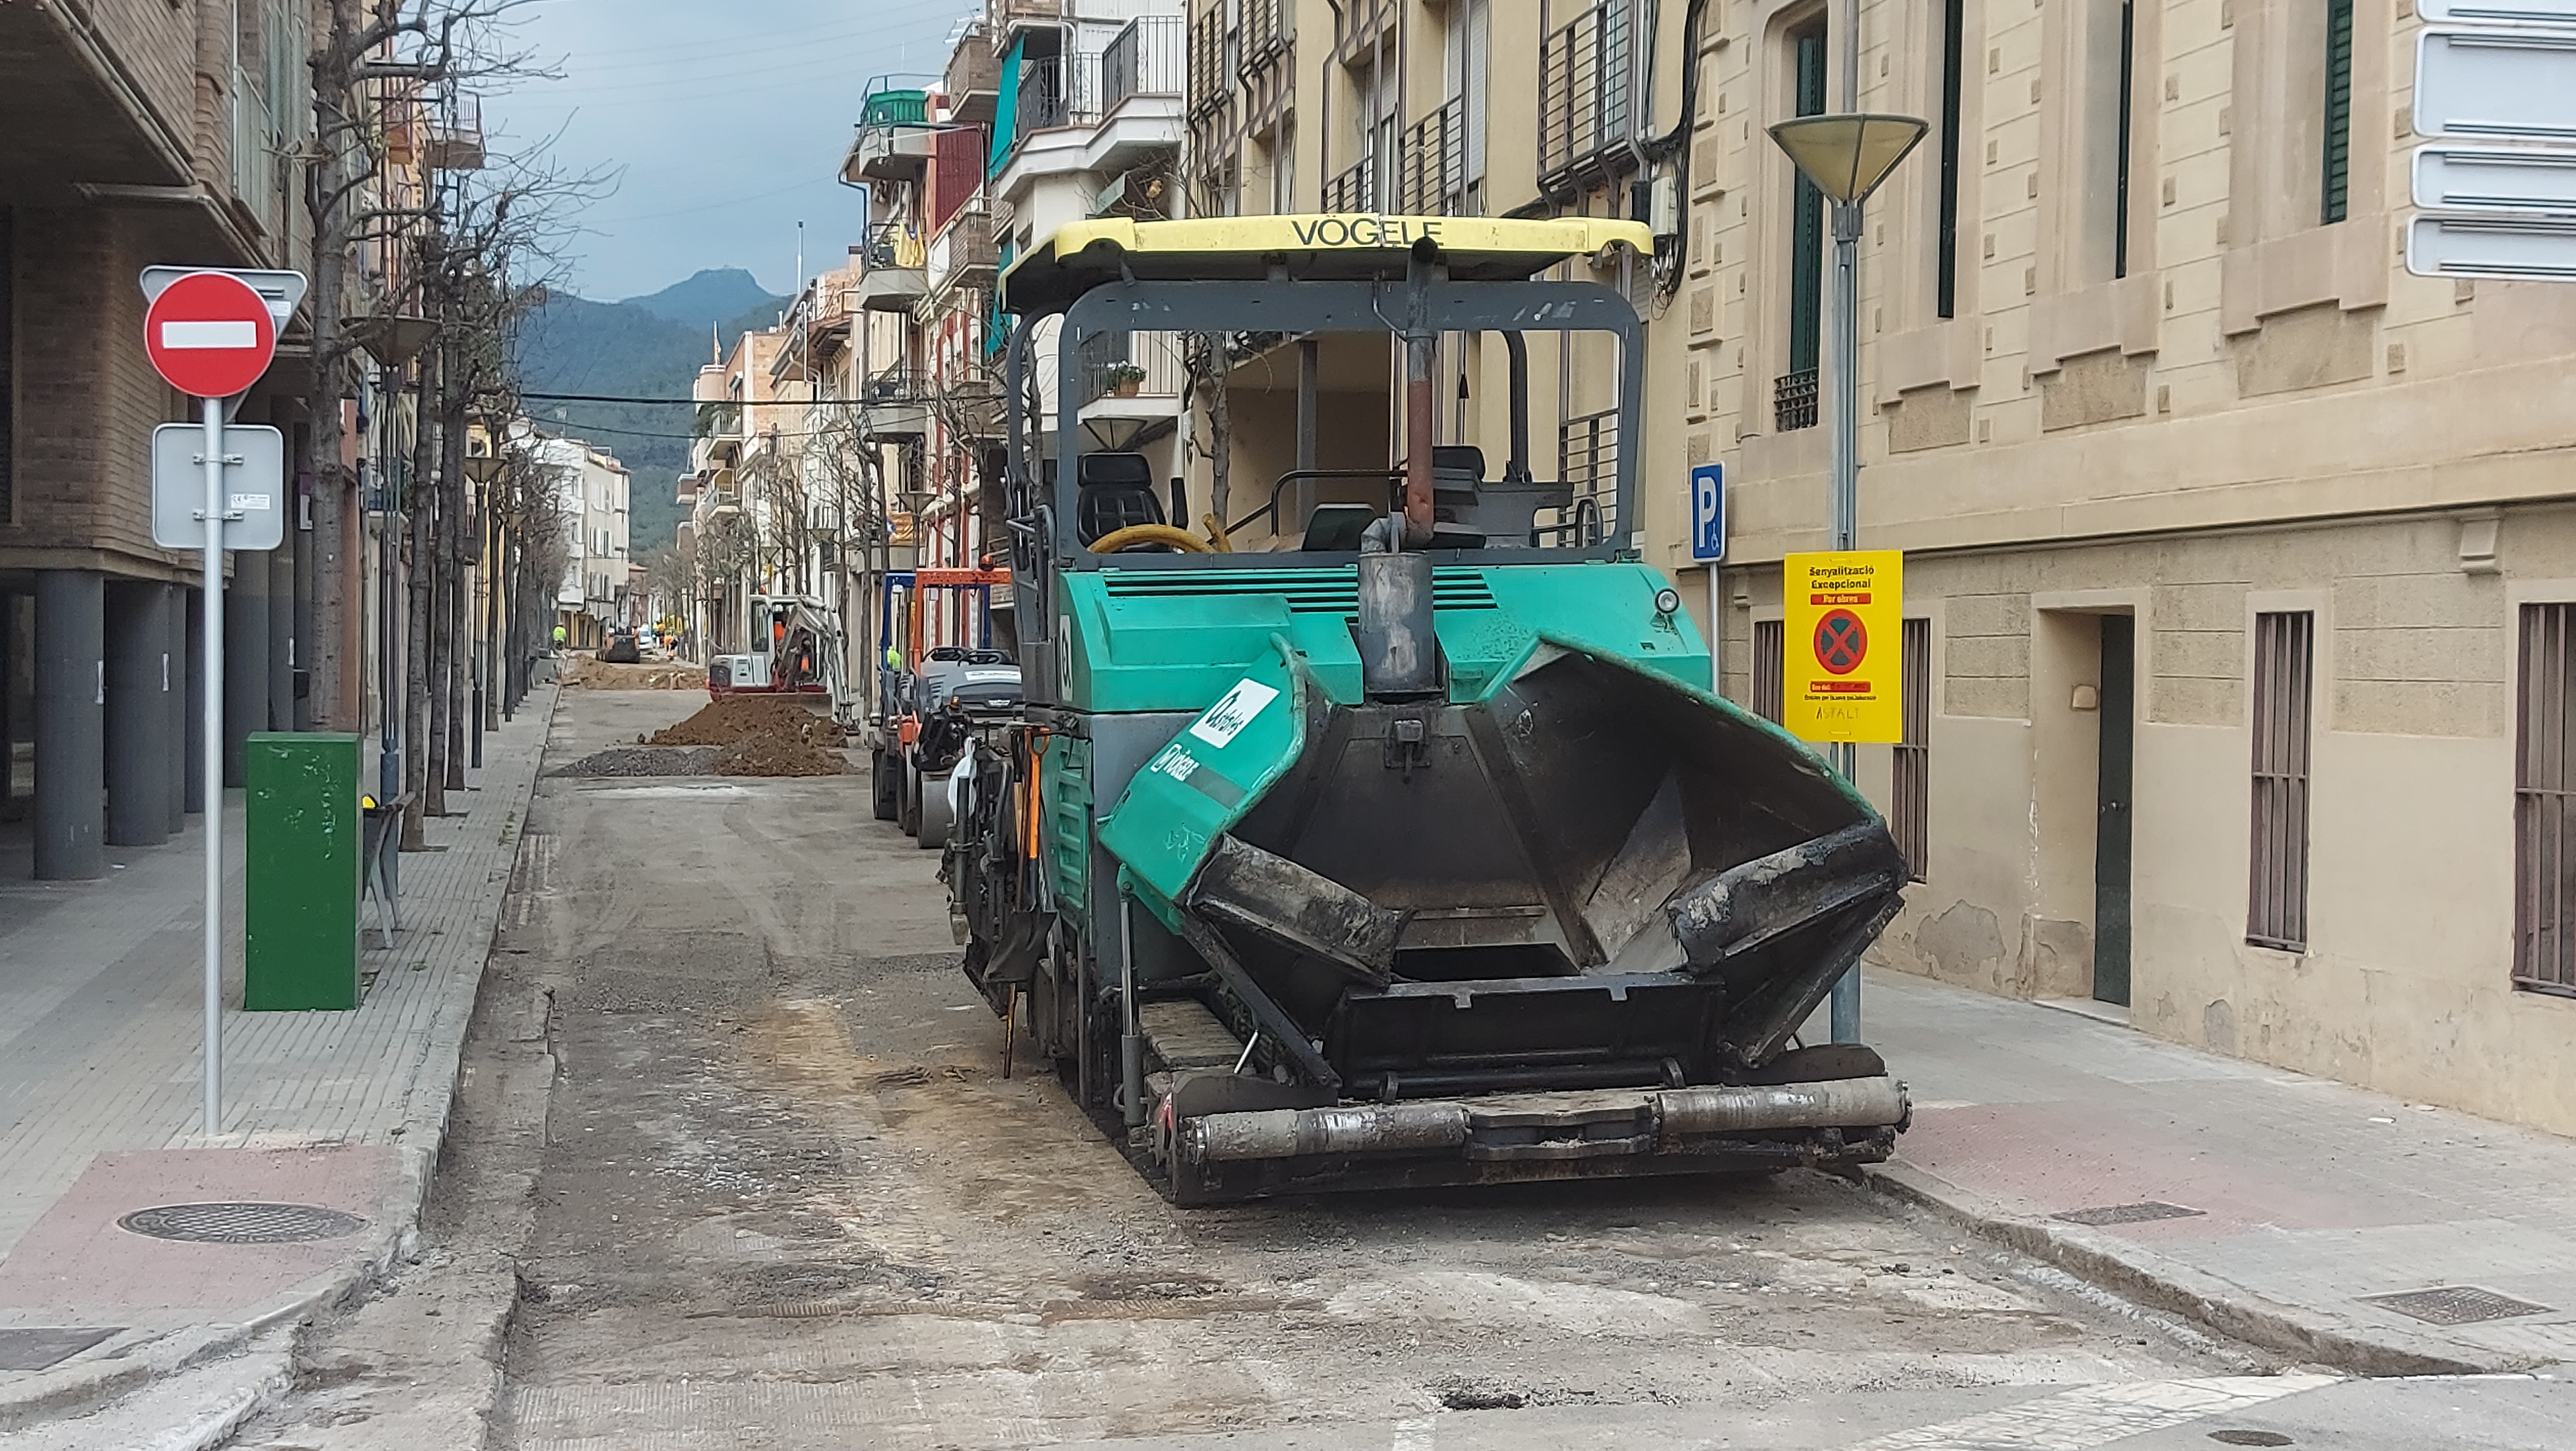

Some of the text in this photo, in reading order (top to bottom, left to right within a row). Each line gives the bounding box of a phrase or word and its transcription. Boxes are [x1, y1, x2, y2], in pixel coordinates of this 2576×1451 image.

[1290, 215, 1444, 246] VÖGELE
[1698, 476, 1717, 548] P
[1808, 563, 1875, 578] Senyalització
[1811, 578, 1871, 591] Excepcional
